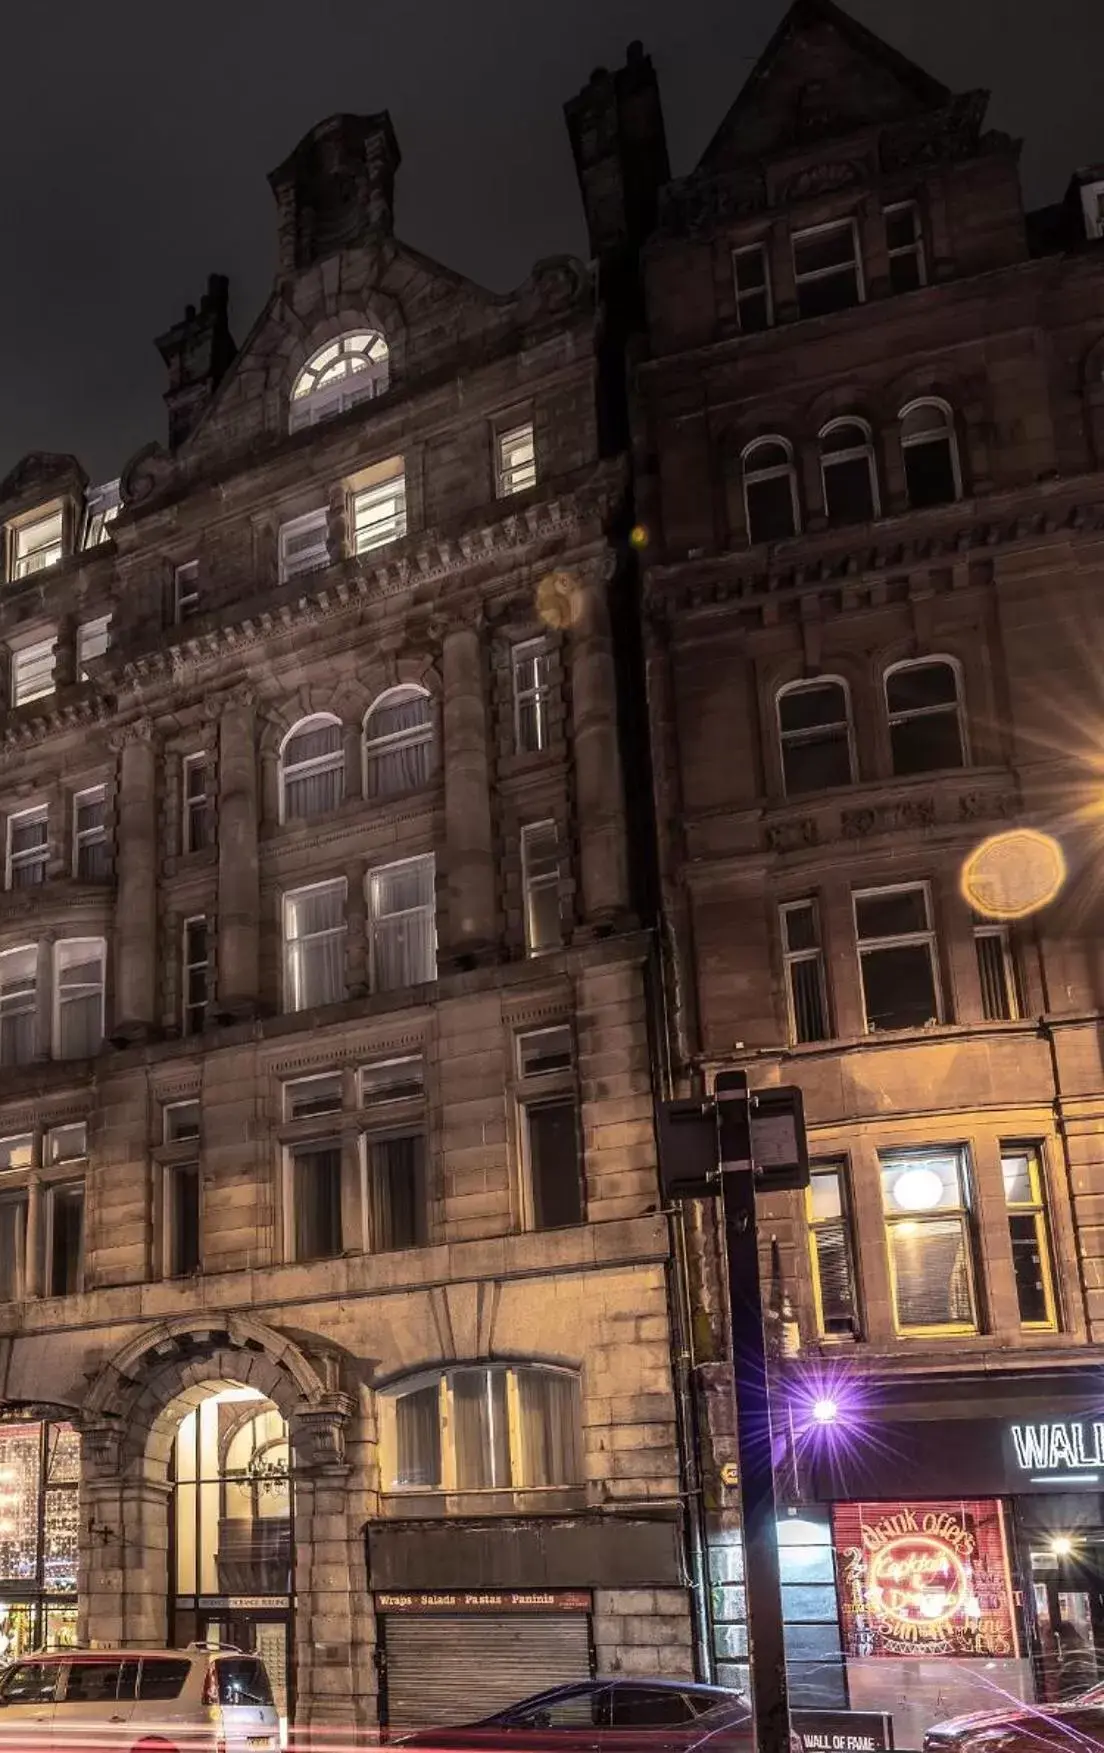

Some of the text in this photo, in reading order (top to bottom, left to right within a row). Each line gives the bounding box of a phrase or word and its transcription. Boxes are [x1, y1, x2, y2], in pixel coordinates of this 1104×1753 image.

[861, 1508, 976, 1555] drink offers
[379, 1594, 412, 1606] Wraps
[420, 1594, 456, 1605] Salads
[464, 1594, 502, 1605] Pastas
[511, 1593, 554, 1605] Paninis
[803, 1734, 875, 1750] WALL OF FAME
